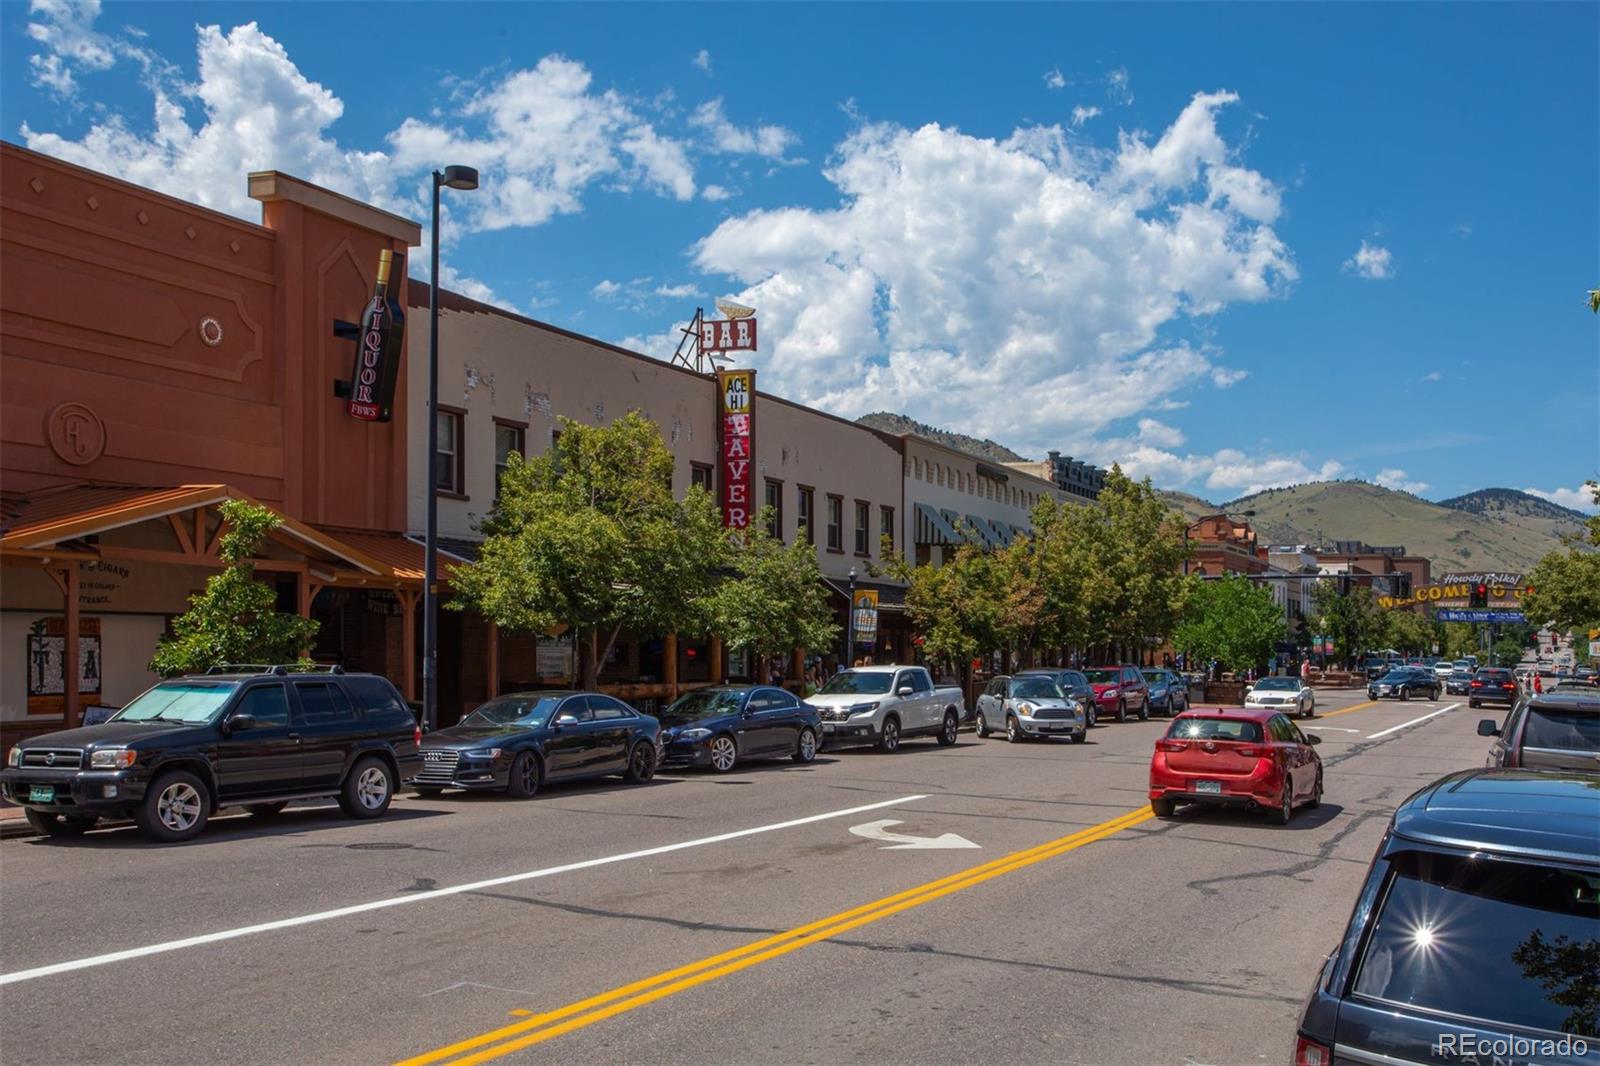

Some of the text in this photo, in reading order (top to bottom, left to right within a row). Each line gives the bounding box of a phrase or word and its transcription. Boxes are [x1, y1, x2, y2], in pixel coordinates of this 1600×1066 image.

[702, 321, 752, 349] BAR
[358, 296, 385, 403] LIQUOR
[726, 377, 748, 394] ACE
[351, 403, 377, 417] FBWS
[730, 394, 744, 410] HI
[1444, 573, 1521, 585] Howdy Folks!
